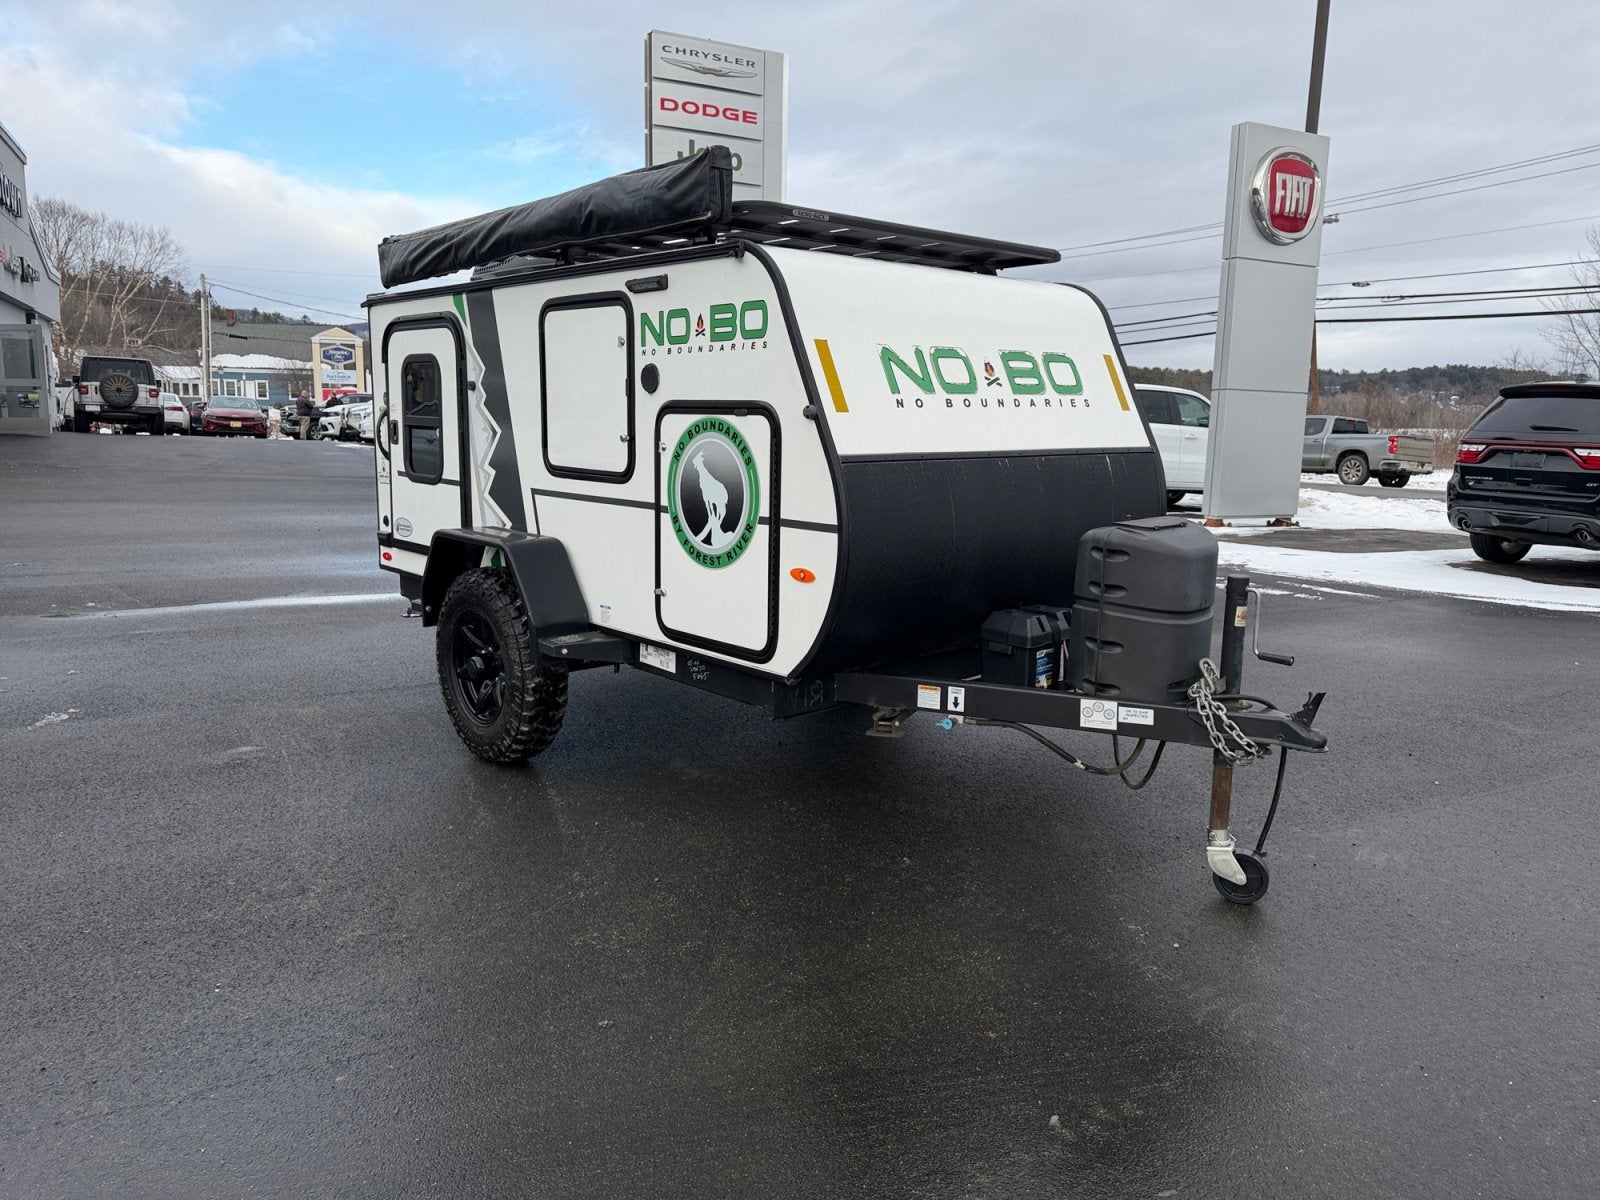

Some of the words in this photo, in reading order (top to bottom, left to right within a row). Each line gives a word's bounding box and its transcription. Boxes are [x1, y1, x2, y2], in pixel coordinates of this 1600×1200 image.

[661, 44, 757, 69] CHRYSLER
[659, 97, 758, 125] DODGE
[1274, 171, 1313, 219] FIAT
[640, 308, 691, 347] NO
[710, 299, 769, 342] BO
[641, 348, 657, 357] NO
[667, 341, 768, 355] BOUNDARIES
[875, 343, 979, 396] NO
[997, 348, 1084, 396] BO
[896, 398, 924, 408] NO
[946, 398, 1091, 409] BOUNDARIES
[673, 441, 686, 462] NO
[687, 420, 752, 466] BOUNDARIES
[672, 514, 684, 535] BY
[683, 538, 722, 566] FOREST
[726, 522, 755, 563] RIVER
